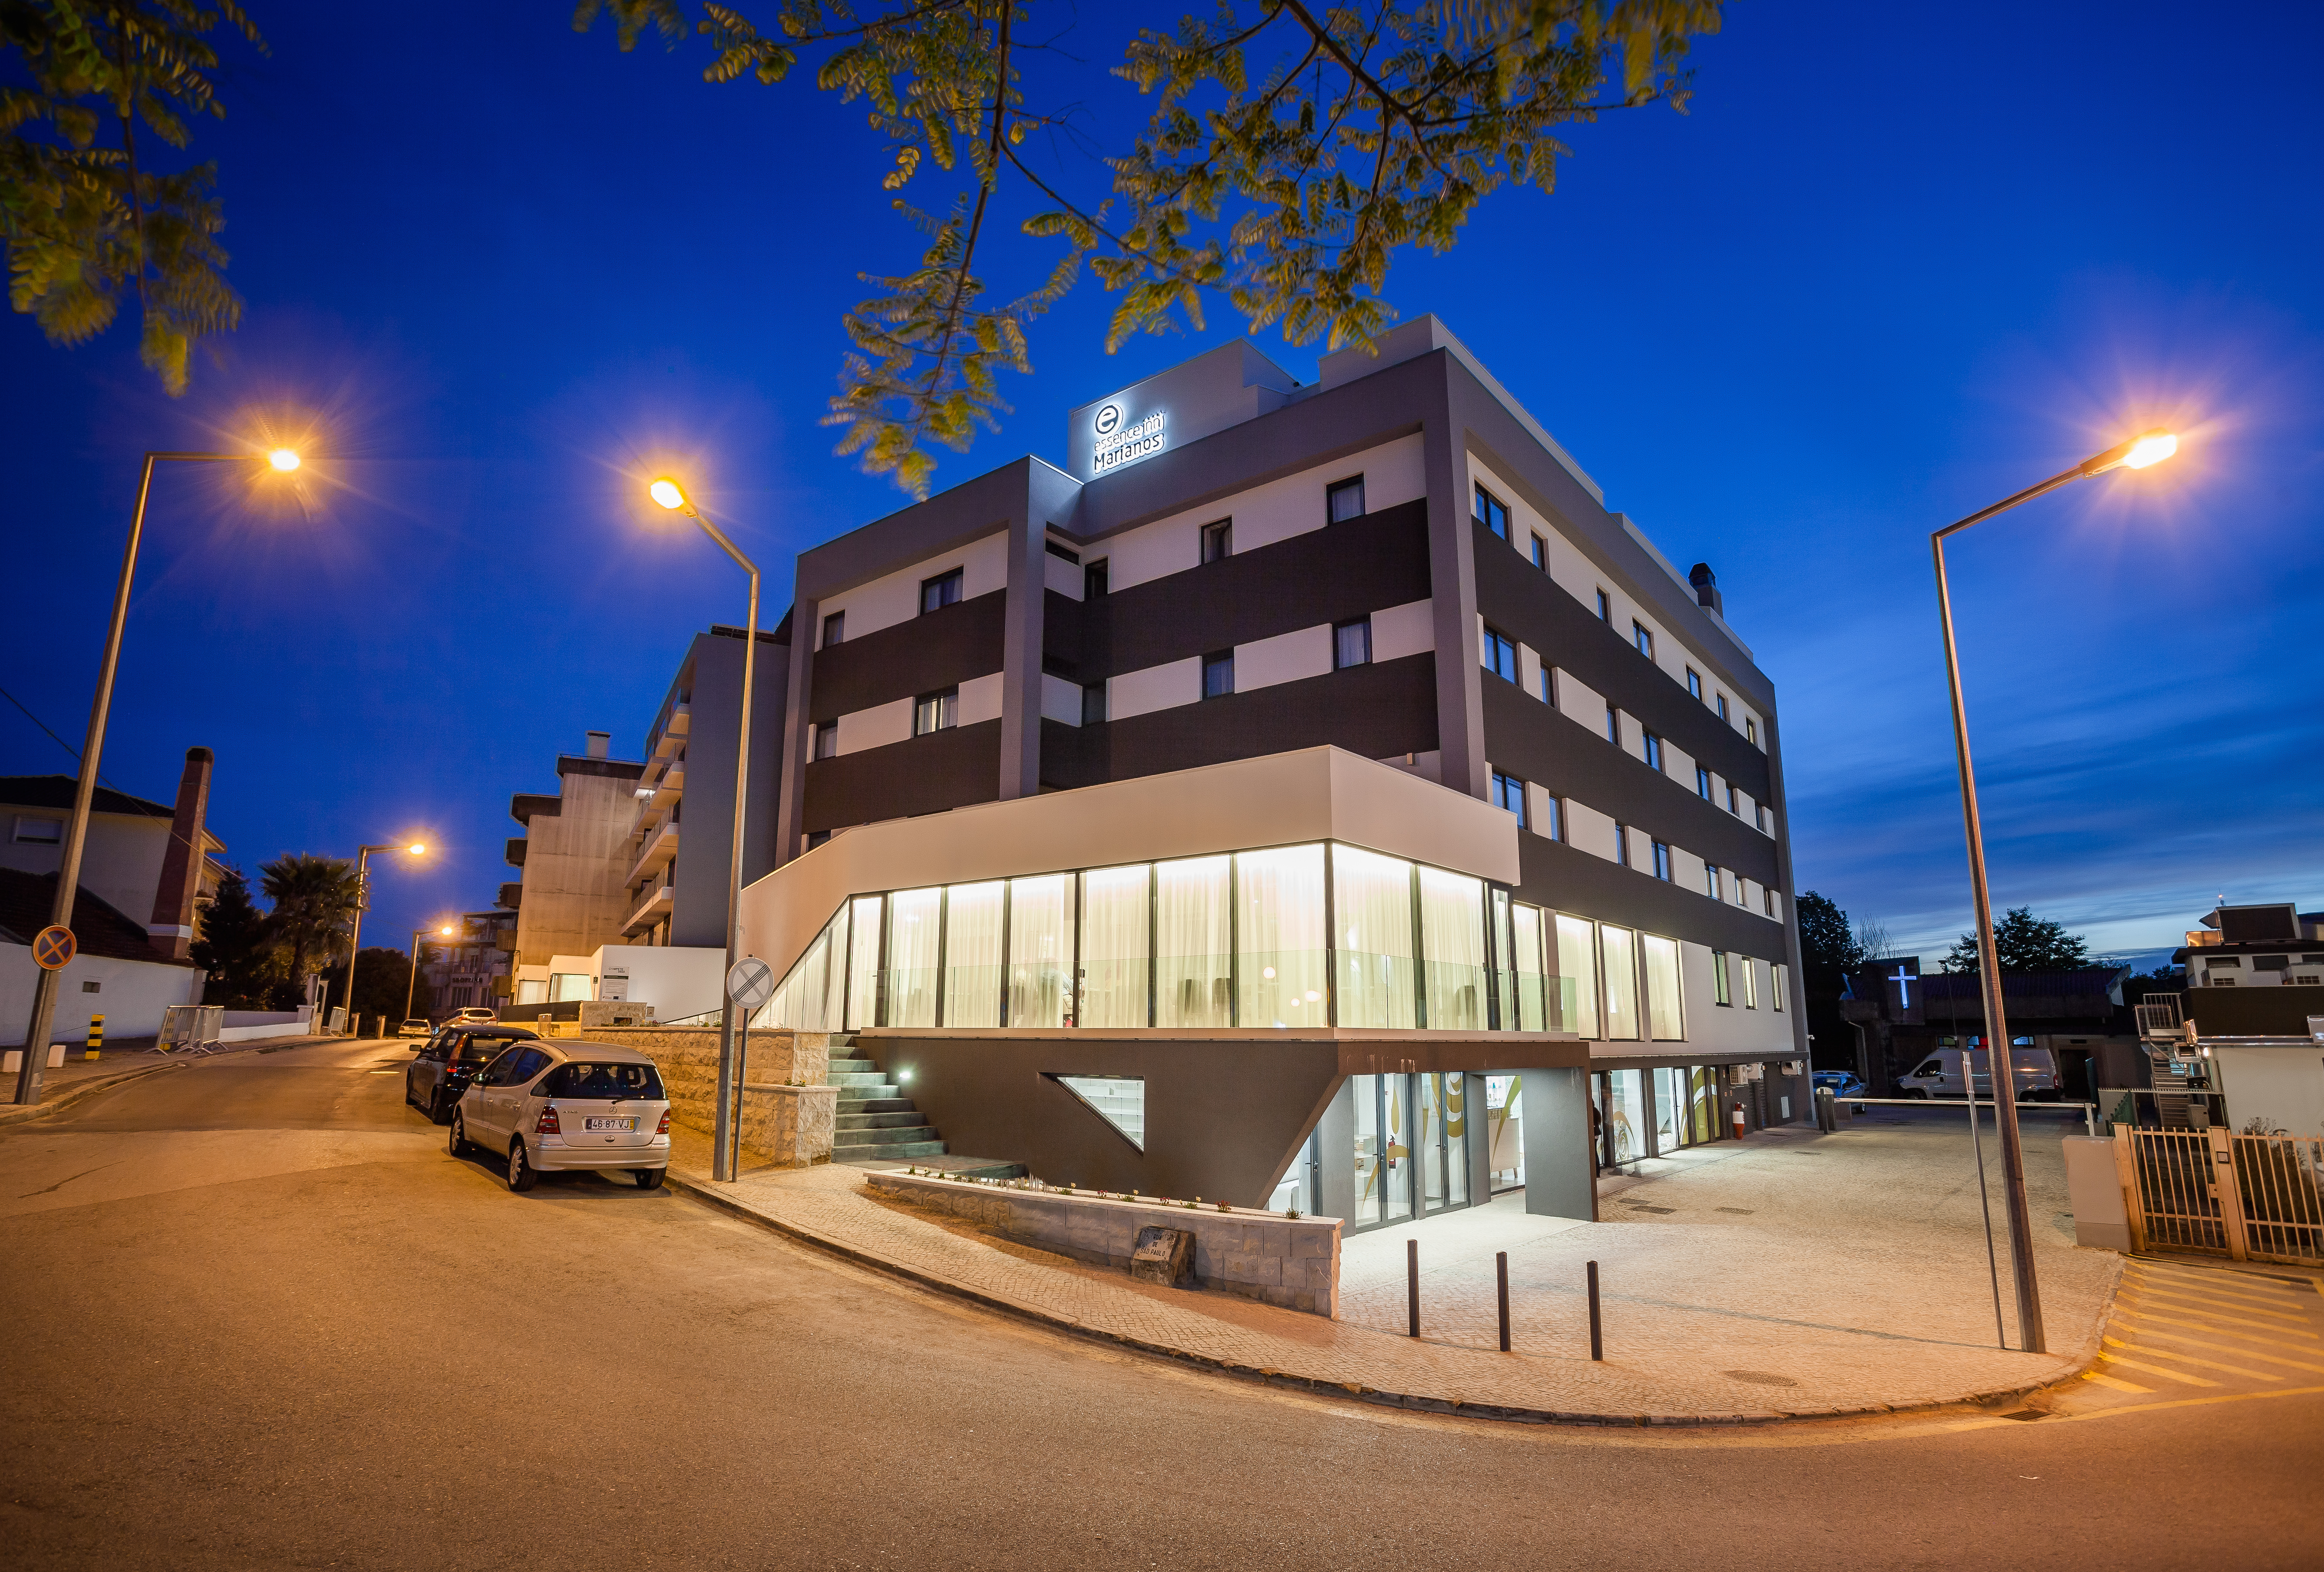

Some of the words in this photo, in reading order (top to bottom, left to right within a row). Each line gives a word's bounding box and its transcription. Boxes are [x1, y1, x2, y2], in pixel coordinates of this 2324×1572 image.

[1095, 426, 1140, 451] essence
[1142, 417, 1161, 434] inn
[1095, 433, 1164, 470] Marianos
